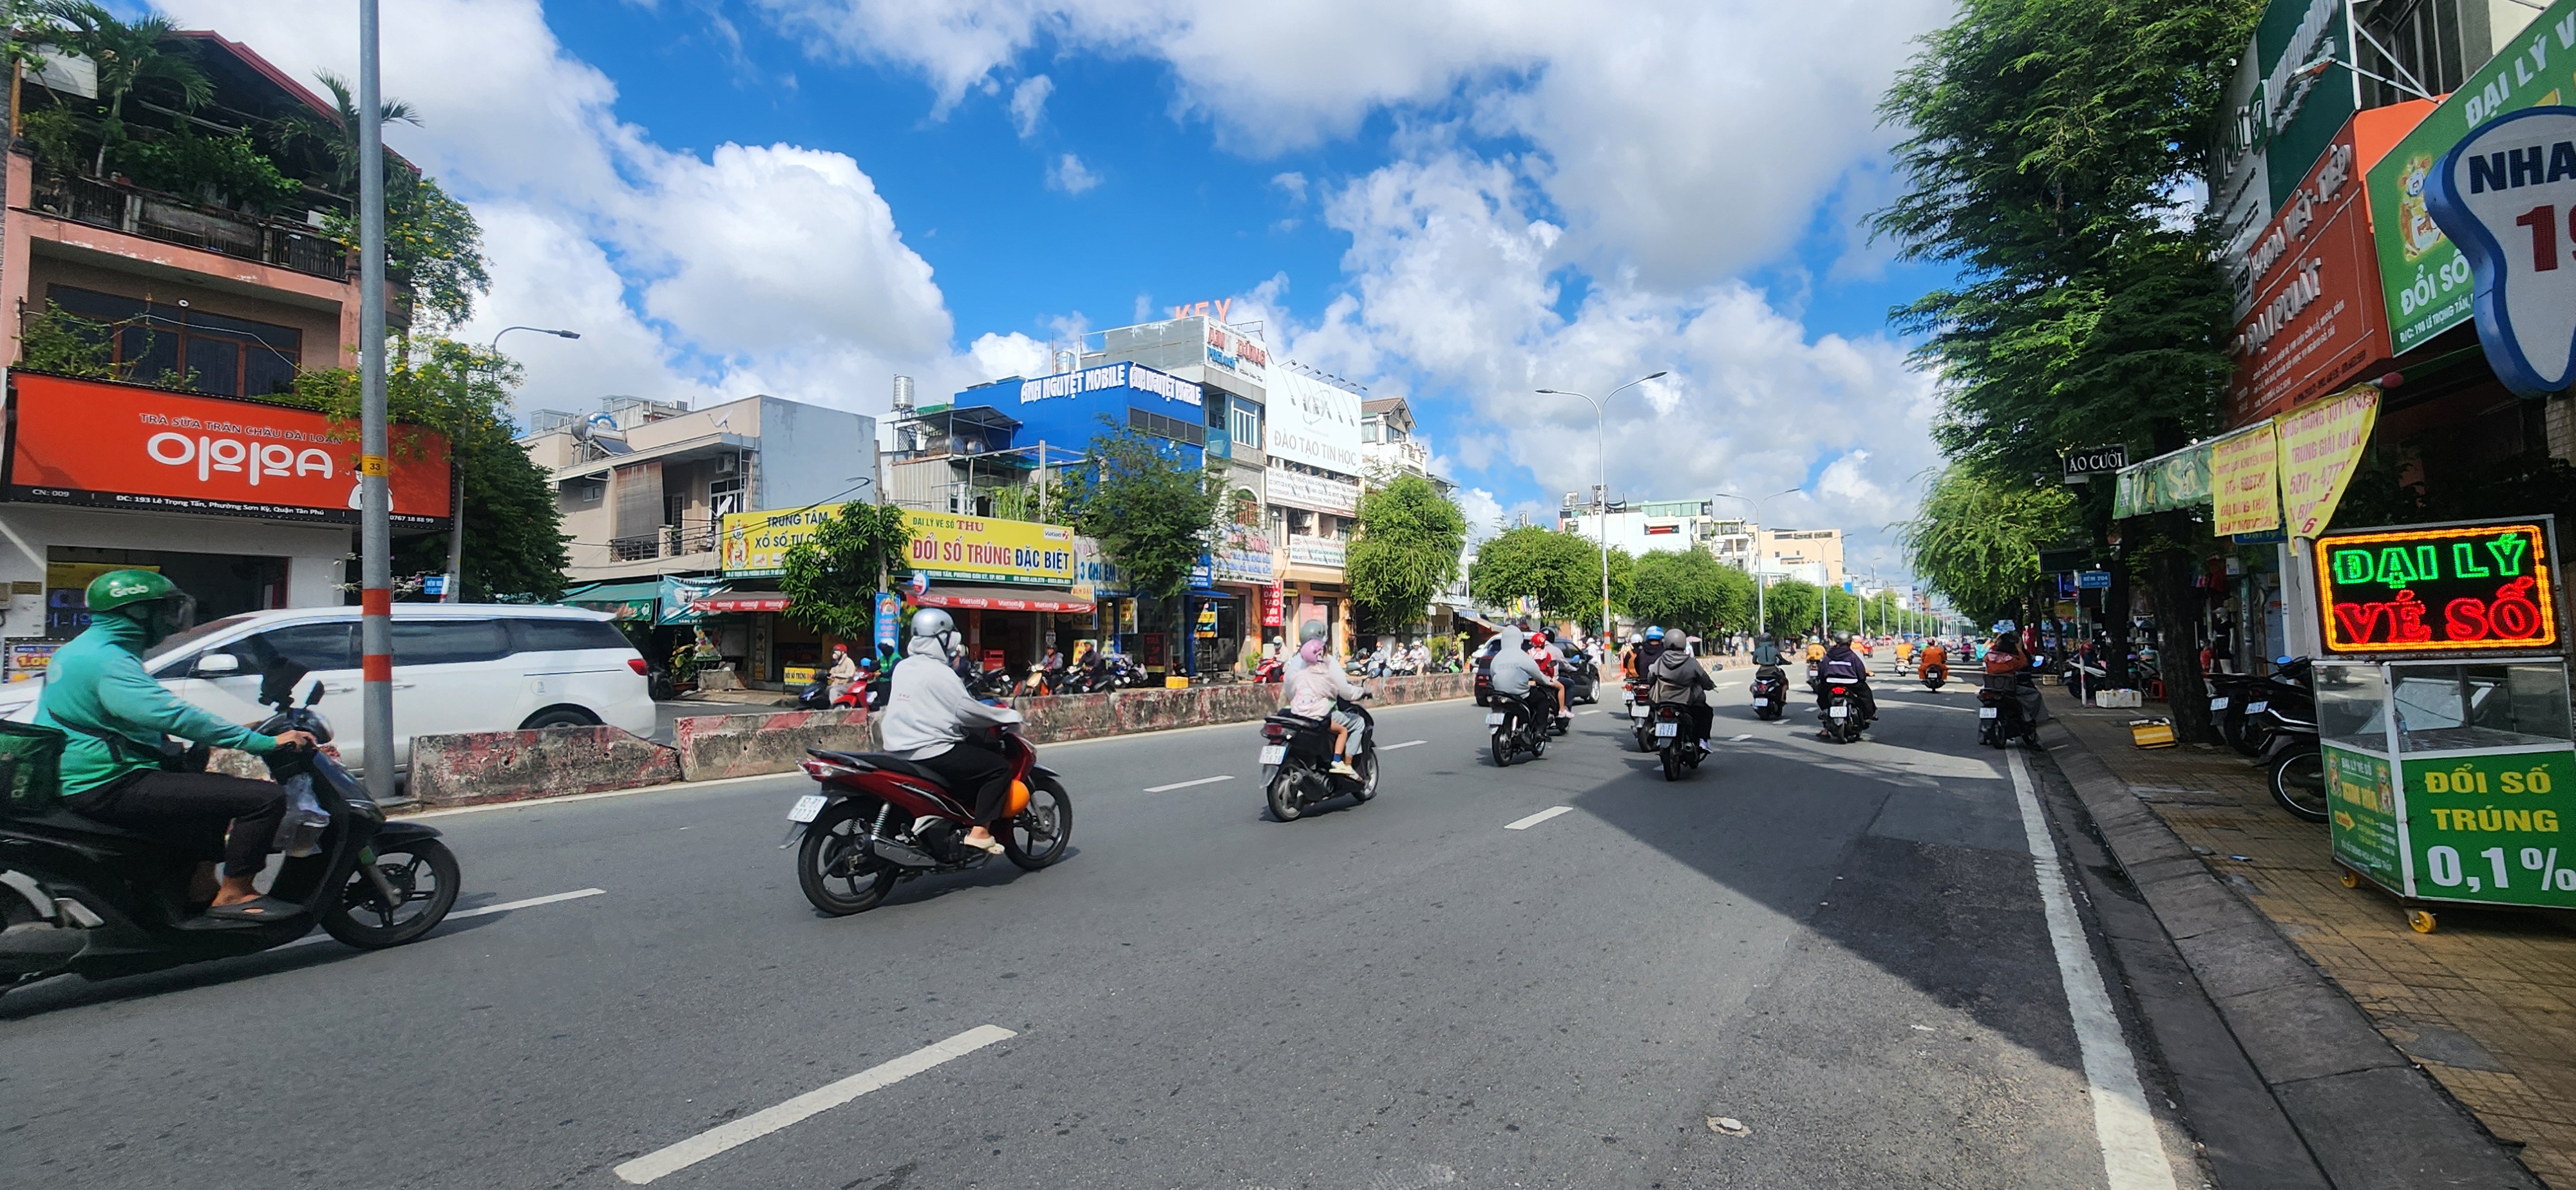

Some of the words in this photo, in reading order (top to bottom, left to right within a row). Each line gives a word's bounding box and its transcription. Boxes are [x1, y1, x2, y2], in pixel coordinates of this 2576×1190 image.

[2465, 71, 2510, 129] ĐẠI
[2515, 33, 2546, 88] LÝ
[2400, 264, 2437, 316] ĐỔI
[1176, 298, 1231, 323] KEY
[1043, 370, 1084, 399] NGUYỆT
[1085, 364, 1126, 392] MOBILE
[1146, 373, 1176, 402] NGUYỆT
[1175, 379, 1202, 406] MOBILE
[140, 413, 168, 424] TRÀ
[173, 417, 202, 430] SỮA
[206, 421, 241, 433] TRÂN
[245, 426, 281, 438] CHÂU
[285, 430, 306, 440] ĐÀI
[310, 434, 343, 445] LOAN
[2338, 430, 2349, 449] AN
[1274, 428, 1297, 450] ĐÀO
[1299, 437, 1319, 458] TẠO
[1321, 444, 1336, 461] TIN
[1338, 448, 1356, 468] HỌC
[2069, 454, 2087, 472] ÁO
[2089, 449, 2123, 470] CƯỚI
[164, 498, 189, 507] Trọng
[190, 500, 207, 508] Tấn,
[209, 502, 242, 511] Phường
[274, 506, 294, 515] Quận
[767, 514, 801, 528] TRUNG
[805, 510, 828, 525] TÂM
[913, 517, 924, 527] ĐẠI
[926, 517, 934, 527] LÝ
[936, 518, 944, 528] VÉ
[945, 518, 954, 529] SỐ
[956, 520, 984, 532] THU
[755, 531, 770, 548] XỔ
[773, 531, 788, 547] SỐ
[913, 532, 938, 560] ĐỔI
[943, 536, 963, 562] SỐ
[967, 542, 1011, 566] TRÚNG
[1016, 545, 1040, 572] ĐẶC
[1045, 549, 1070, 574] BIỆT
[1080, 561, 1085, 580] 3
[1104, 562, 1115, 581] EM
[2334, 545, 2439, 589] ĐẠI
[2452, 533, 2526, 578] LÝ
[109, 583, 149, 598] Grab
[959, 597, 981, 605] Vietlott
[1264, 589, 1280, 598] ĐÀO
[2333, 589, 2432, 644] VÉ
[2445, 576, 2541, 642] SỐ
[2425, 763, 2488, 793] ĐỔI
[2500, 764, 2552, 794] SỐ
[2430, 804, 2559, 833] TRÚNG
